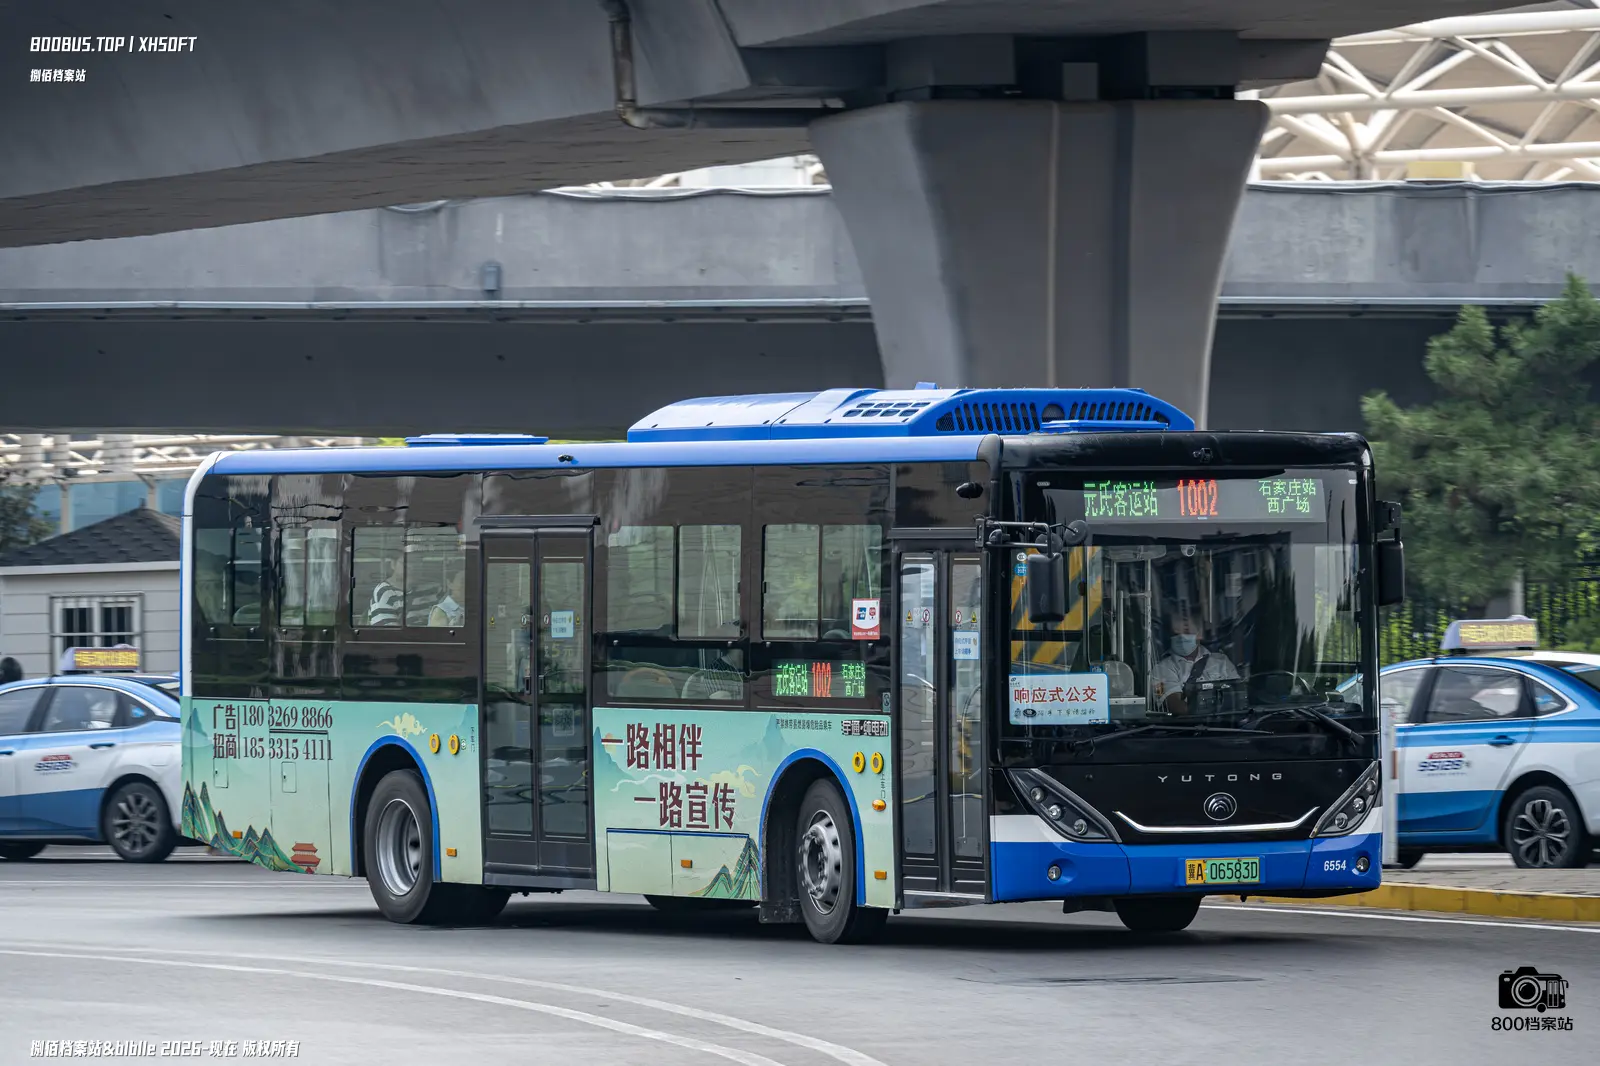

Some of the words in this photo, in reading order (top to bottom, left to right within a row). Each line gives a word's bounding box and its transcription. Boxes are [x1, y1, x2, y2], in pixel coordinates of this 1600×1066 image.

[1258, 478, 1317, 497] 石家庄站
[1083, 480, 1159, 517] 元氏客运站
[1177, 479, 1219, 516] 1002
[1266, 496, 1311, 514] 西广场
[1013, 685, 1098, 704] 响应式公交
[213, 705, 237, 729] 广告
[243, 705, 265, 727] 180
[268, 706, 298, 728] 3269
[301, 707, 333, 729] 8866
[213, 734, 237, 760] 招商
[243, 737, 265, 760] 185
[268, 738, 299, 760] 3315
[302, 739, 334, 761] 4111
[601, 722, 703, 771] 一路相伴
[1158, 772, 1282, 783] YUTONG
[633, 781, 736, 830] 一路宣传
[1210, 862, 1258, 880] 06583D
[1323, 859, 1347, 872] 6554
